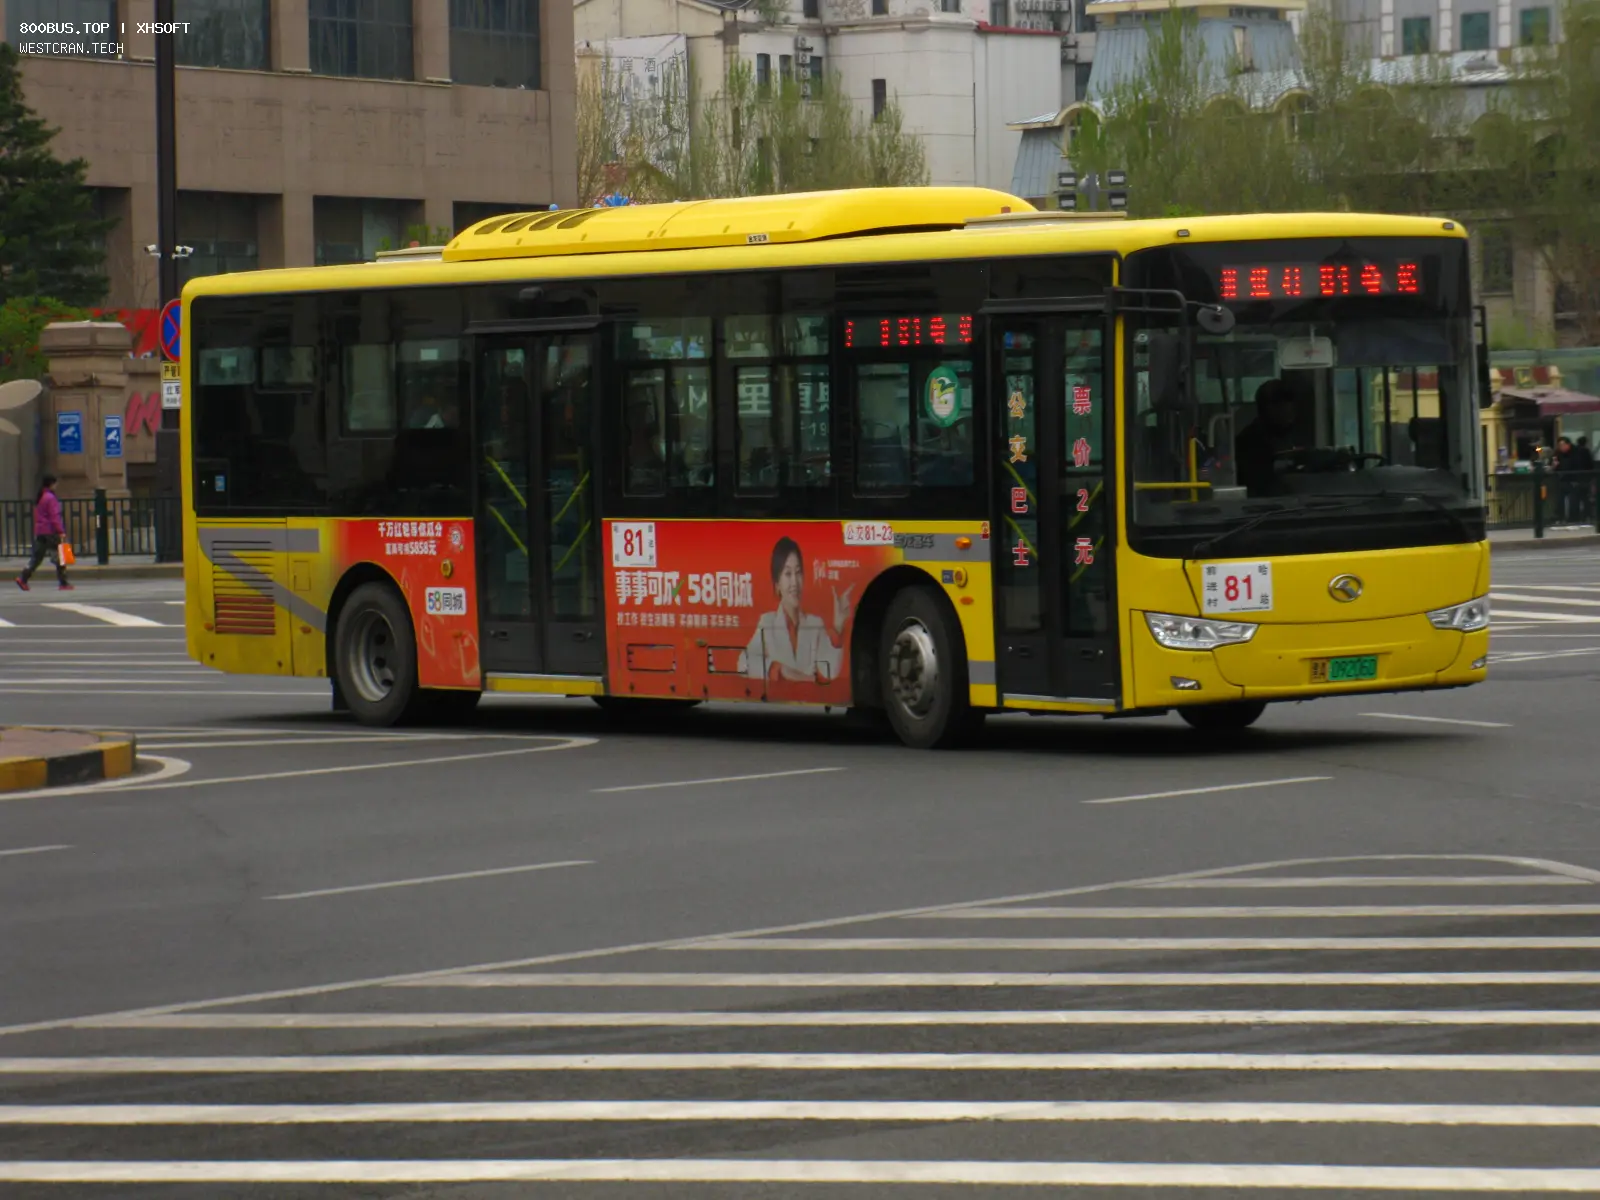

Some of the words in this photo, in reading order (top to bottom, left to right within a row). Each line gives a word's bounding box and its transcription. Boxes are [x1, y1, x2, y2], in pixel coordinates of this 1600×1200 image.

[623, 529, 644, 557] 81
[846, 524, 893, 541] 公交81-23
[427, 591, 464, 611] 58同城
[687, 570, 754, 607] 58同城
[1224, 574, 1253, 602] 81
